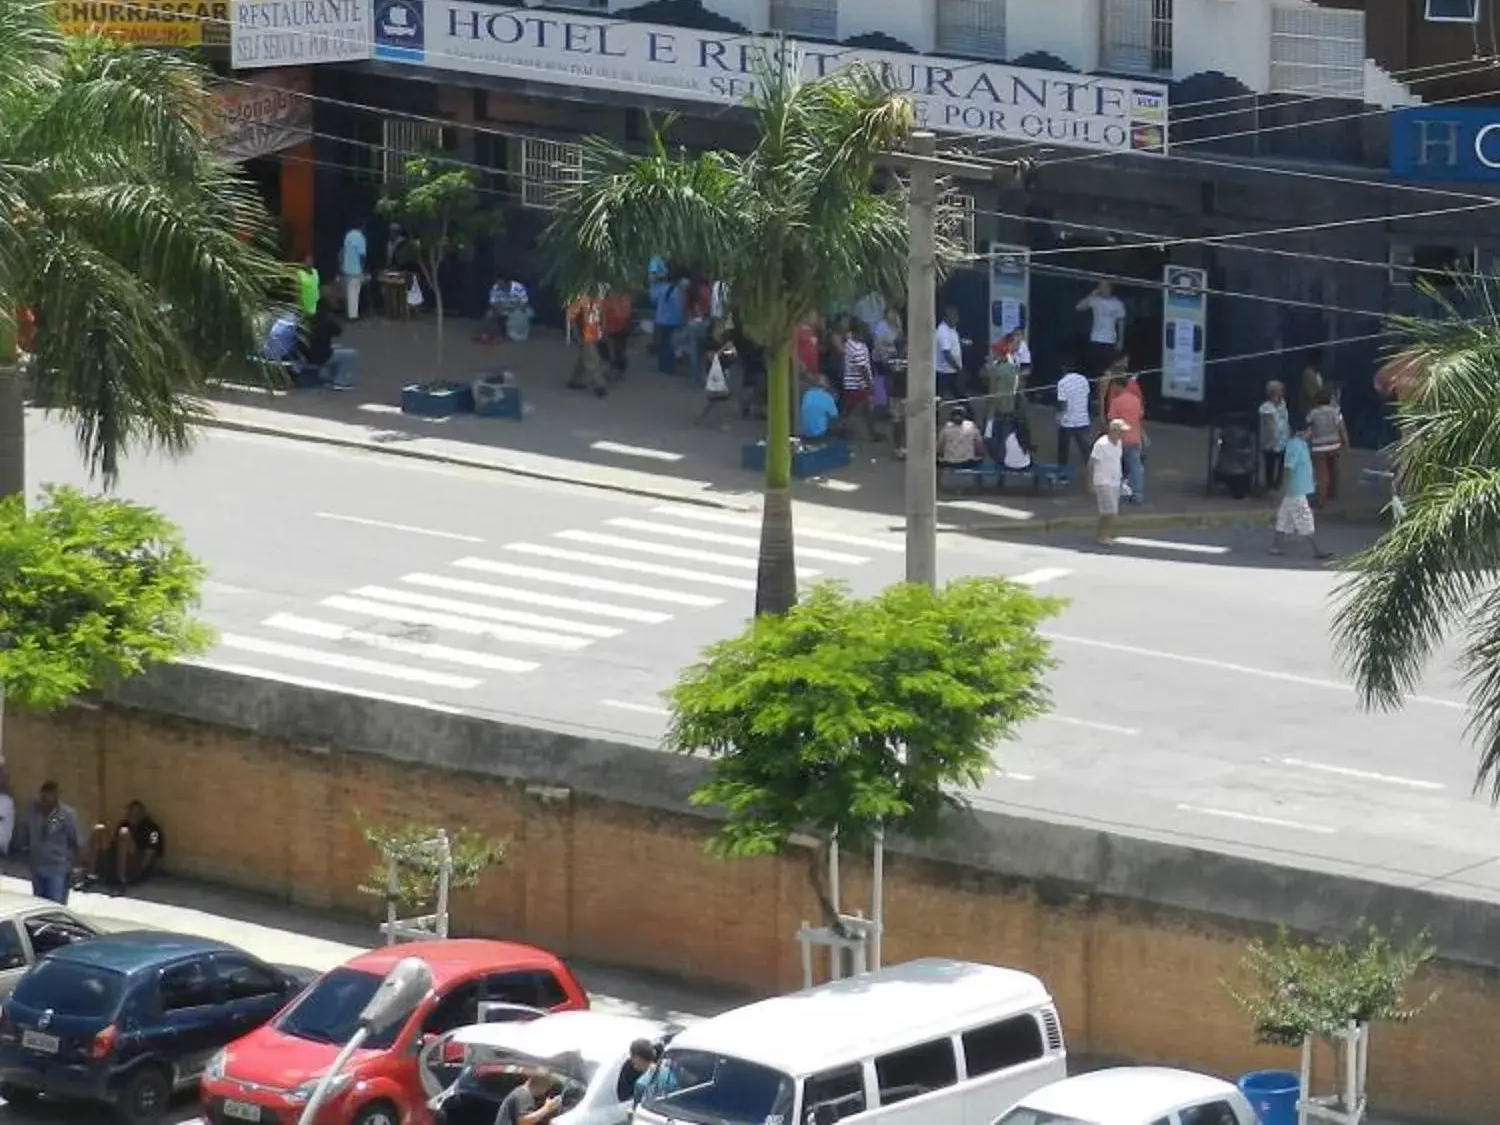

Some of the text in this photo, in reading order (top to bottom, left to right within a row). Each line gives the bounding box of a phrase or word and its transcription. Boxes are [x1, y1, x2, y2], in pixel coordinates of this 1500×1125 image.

[55, 1, 231, 23] CHURRASCAR
[448, 8, 626, 56] HOTEL
[645, 31, 677, 64] E
[946, 105, 1007, 131] POR
